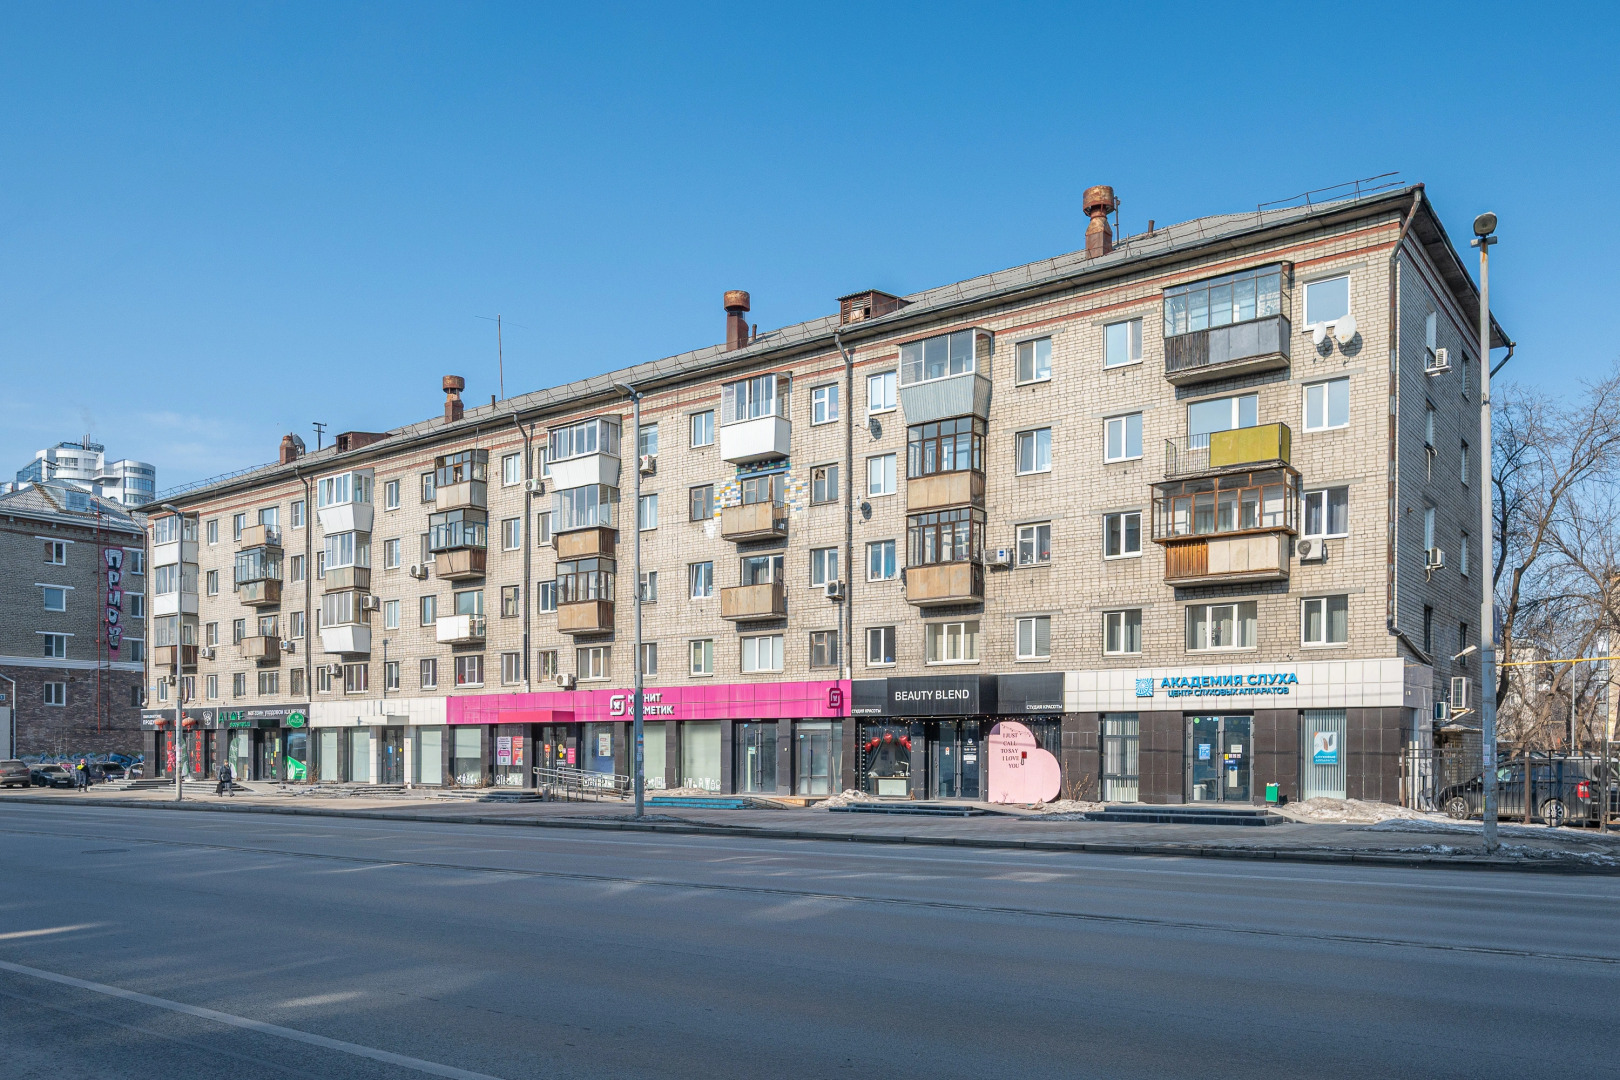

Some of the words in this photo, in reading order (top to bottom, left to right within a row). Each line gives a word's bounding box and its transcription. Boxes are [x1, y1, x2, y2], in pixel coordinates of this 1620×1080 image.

[1161, 675, 1243, 688] АКАДЕМИЯ
[1246, 673, 1299, 686] СЛУХА
[628, 693, 662, 703] МНИТ
[895, 691, 933, 701] BEAUTY
[935, 689, 969, 700] BLEND
[1168, 689, 1193, 698] ЦЕНТР
[1194, 688, 1238, 697] СЛУХОВЫХ
[1239, 686, 1289, 695] АППАРАТОВ
[628, 705, 675, 716] КМЕТИК
